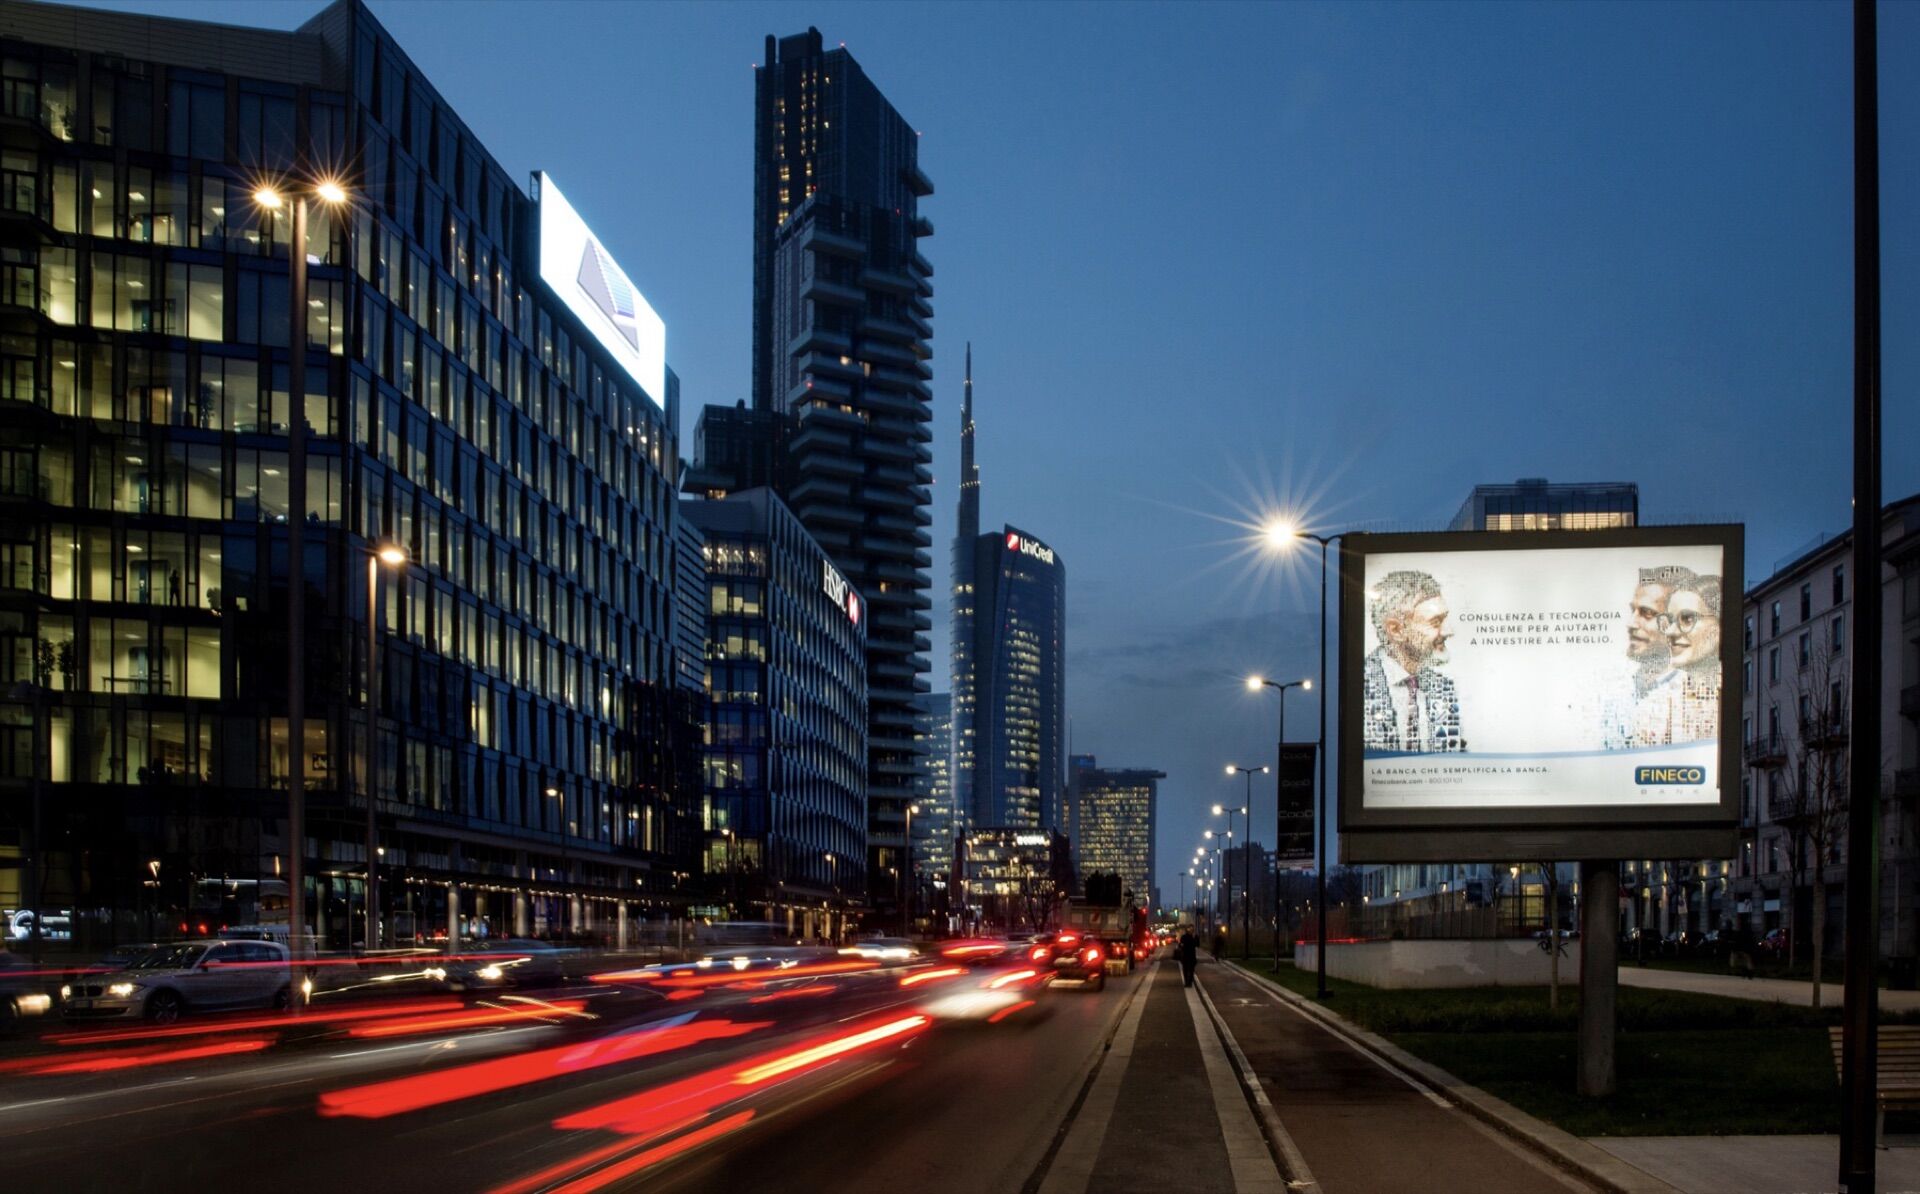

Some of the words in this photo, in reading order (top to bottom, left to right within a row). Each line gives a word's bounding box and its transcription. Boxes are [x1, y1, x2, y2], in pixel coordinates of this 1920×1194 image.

[1020, 536, 1054, 566] UniCredit
[823, 559, 848, 613] HSBC
[1459, 611, 1534, 622] CONSULENZA
[1538, 612, 1545, 621] E
[1549, 611, 1622, 620] TECNOLOGIA
[1476, 624, 1523, 633] INSIEME
[1527, 624, 1549, 633] PER
[1554, 623, 1608, 632] AIUTARTI
[1470, 637, 1477, 645] A
[1482, 636, 1542, 645] INVESTIRE
[1547, 636, 1560, 644] AL
[1565, 635, 1614, 644] MEGLIO.
[1640, 769, 1701, 782] FINECO
